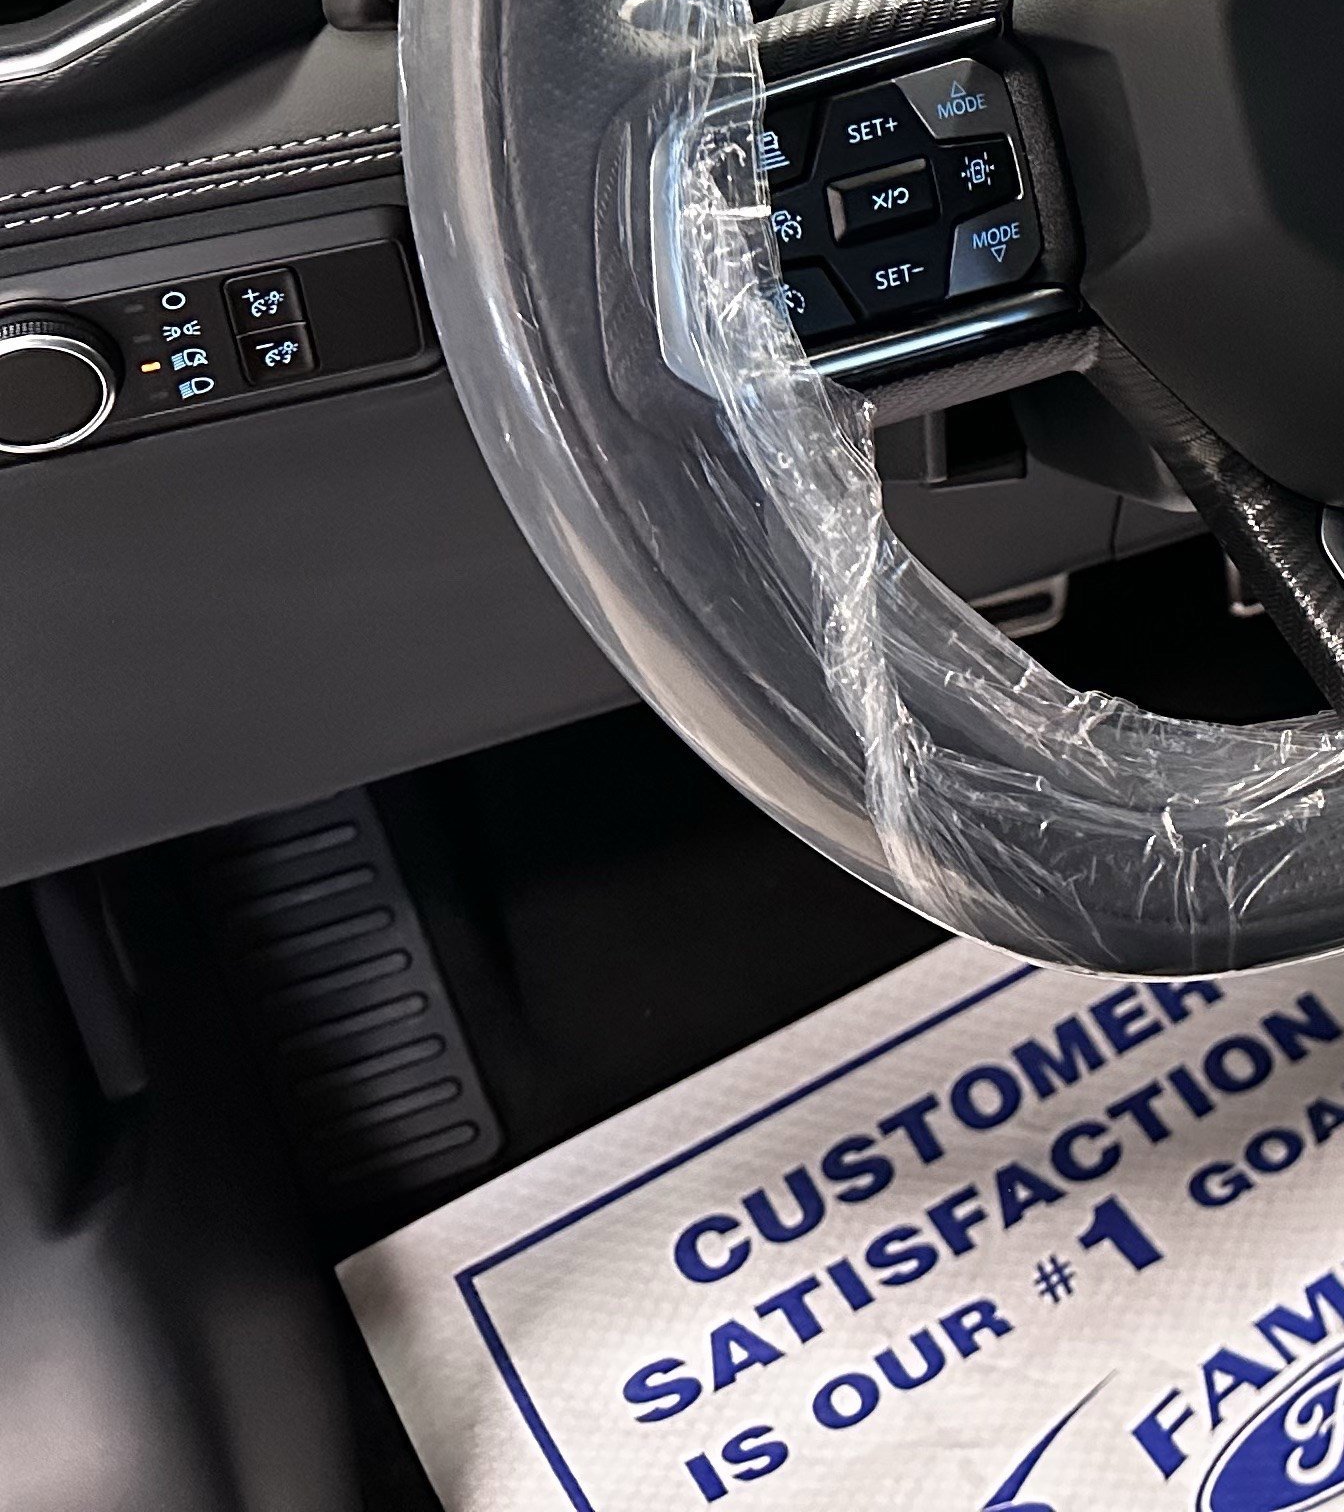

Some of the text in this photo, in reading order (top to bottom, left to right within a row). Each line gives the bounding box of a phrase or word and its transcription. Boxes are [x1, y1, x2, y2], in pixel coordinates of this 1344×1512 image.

[937, 93, 987, 119] MODE
[847, 117, 898, 144] SET+
[972, 222, 1021, 249] MODE
[875, 263, 924, 290] SET-
[673, 980, 1224, 1283] CUSTOMER
[622, 991, 1344, 1423] SATISFACTION
[684, 1425, 790, 1504] IS
[812, 1298, 1012, 1430] OUR
[1033, 1194, 1165, 1305] #1
